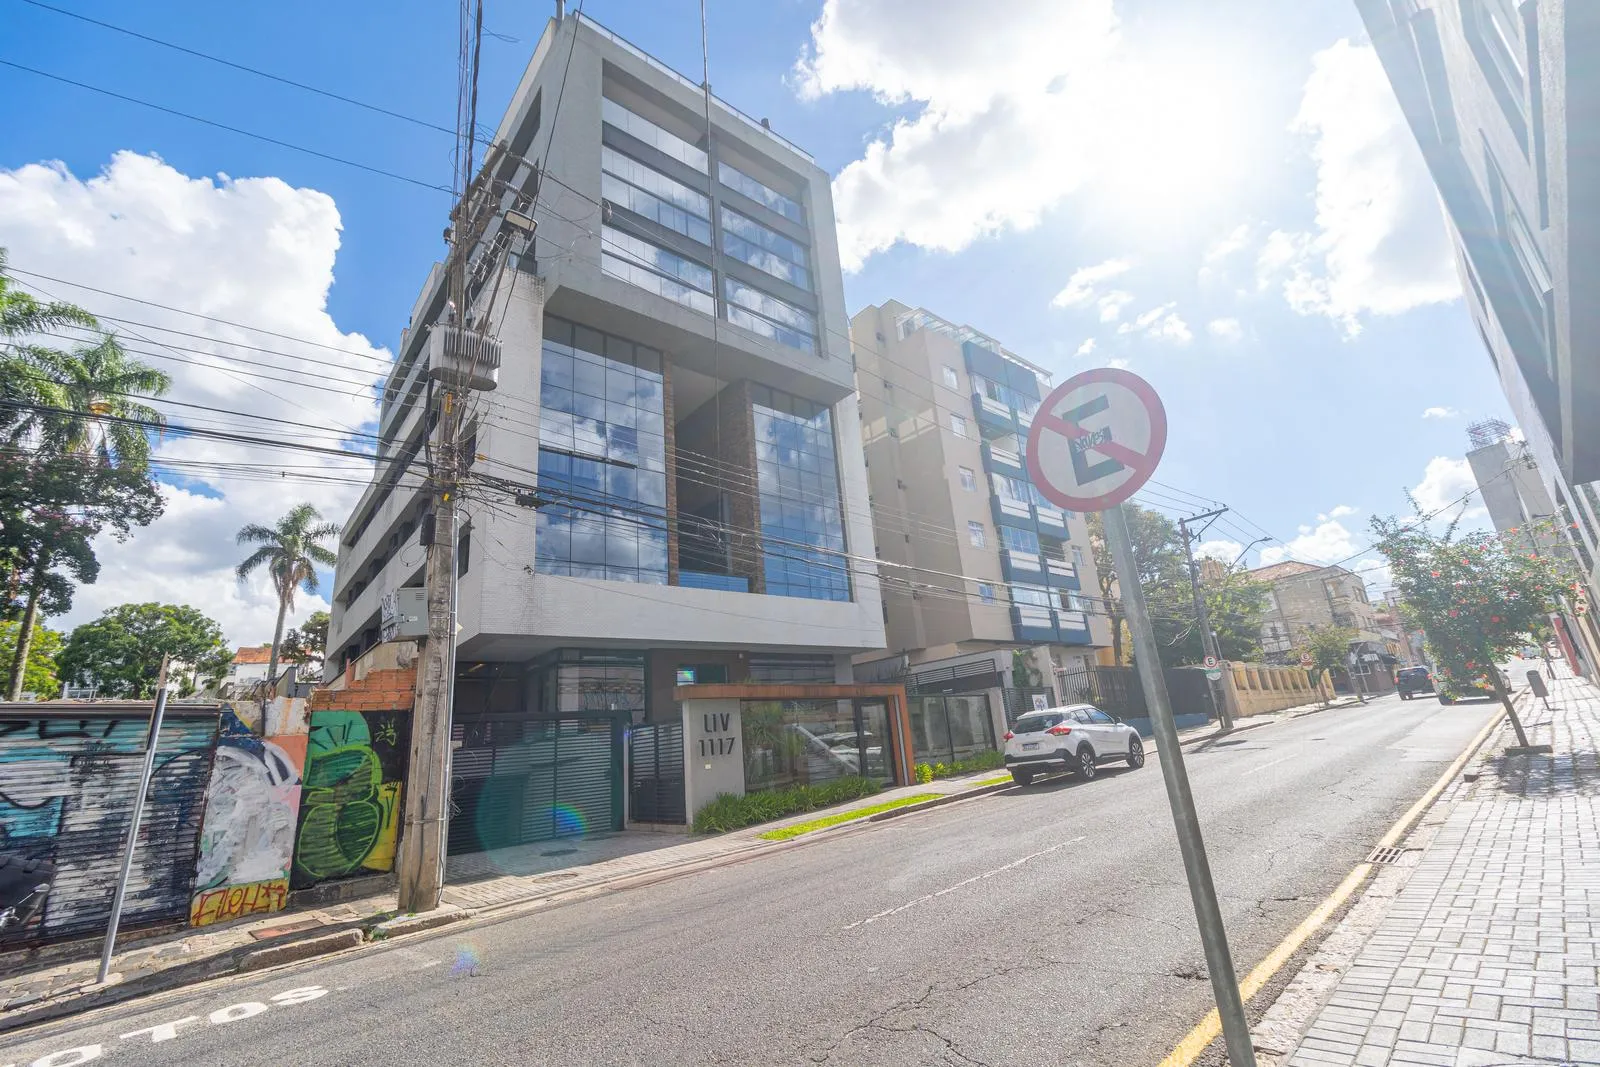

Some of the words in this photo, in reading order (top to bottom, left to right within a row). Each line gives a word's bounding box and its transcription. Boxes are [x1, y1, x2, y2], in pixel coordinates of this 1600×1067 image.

[1062, 394, 1125, 486] E
[698, 736, 736, 757] 1117
[0, 986, 329, 1067] OTOS
